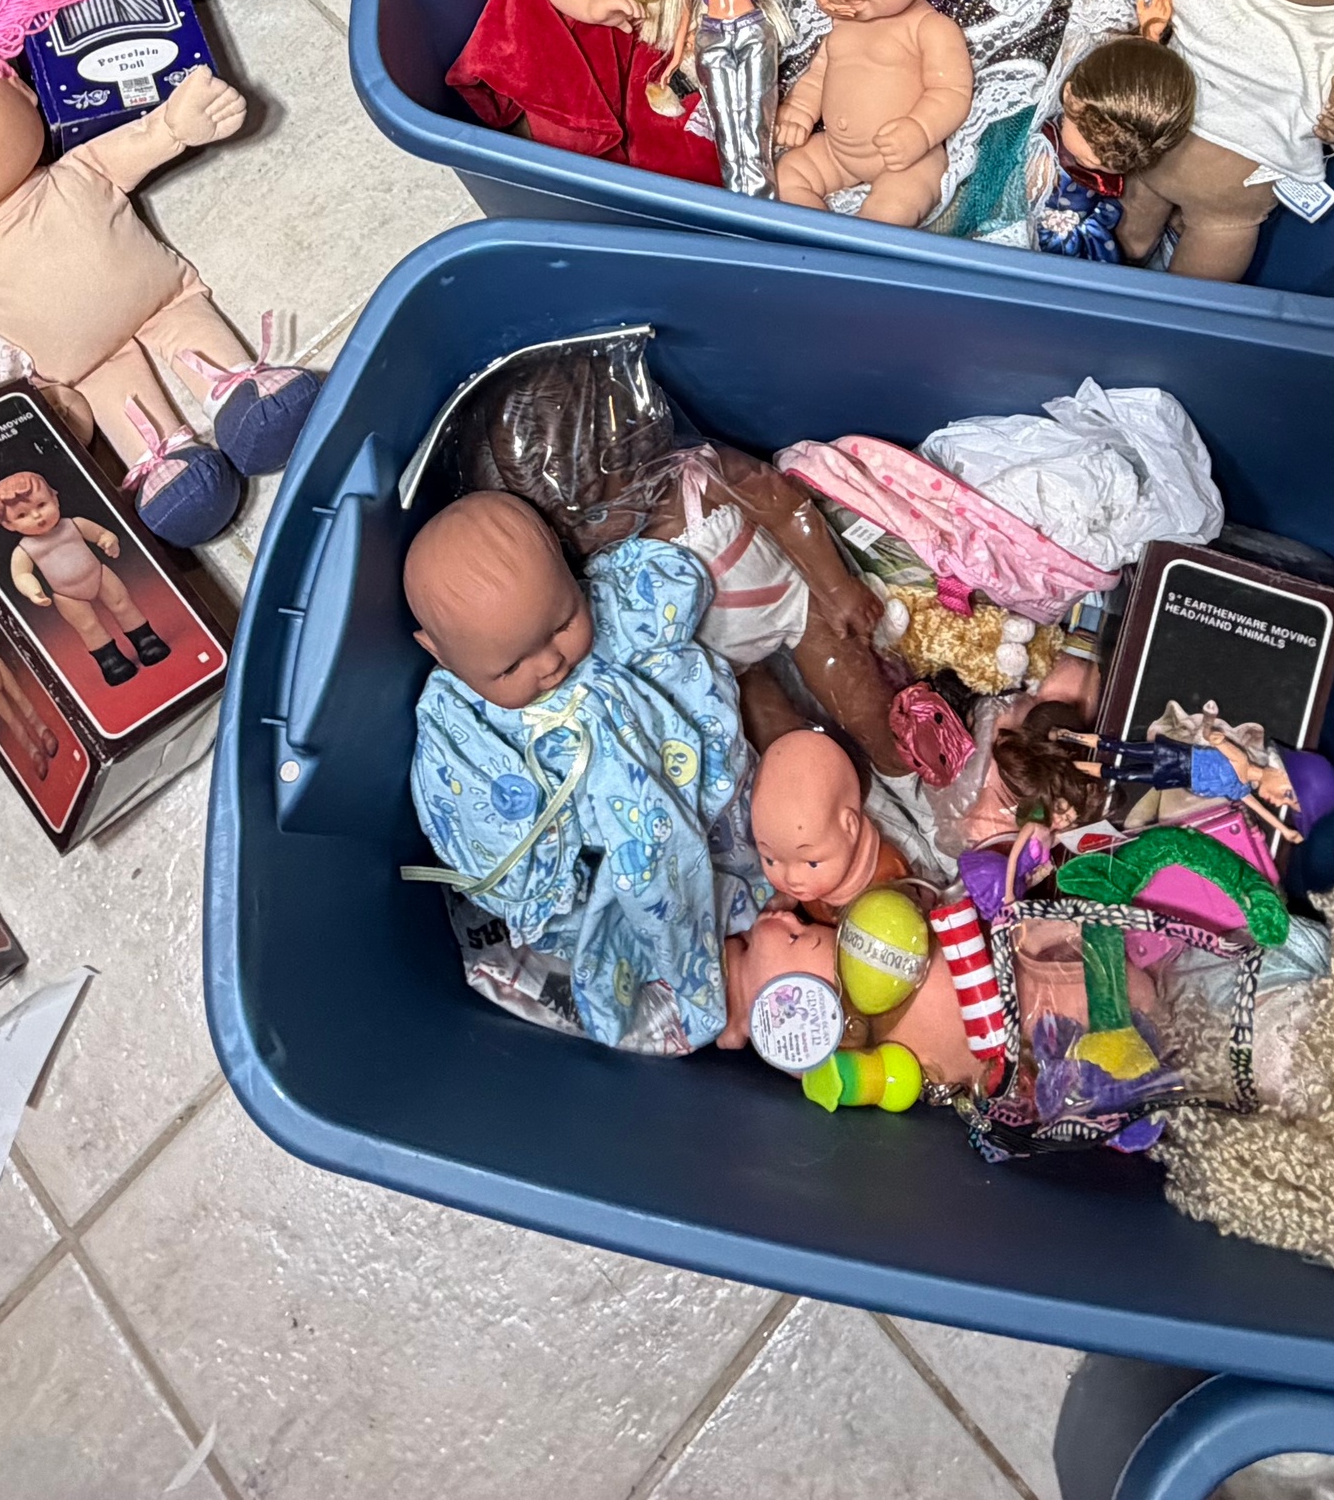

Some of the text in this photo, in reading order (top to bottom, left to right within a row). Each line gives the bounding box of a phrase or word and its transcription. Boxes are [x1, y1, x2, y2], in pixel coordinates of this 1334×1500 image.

[98, 47, 159, 67] Porcelain
[119, 60, 144, 71] Doll
[0, 411, 34, 432] MOVING
[1165, 602, 1286, 649] HEAD/HAND ANIMALS
[1183, 597, 1269, 632] EARTHENWARE
[1270, 624, 1317, 648] MOVING
